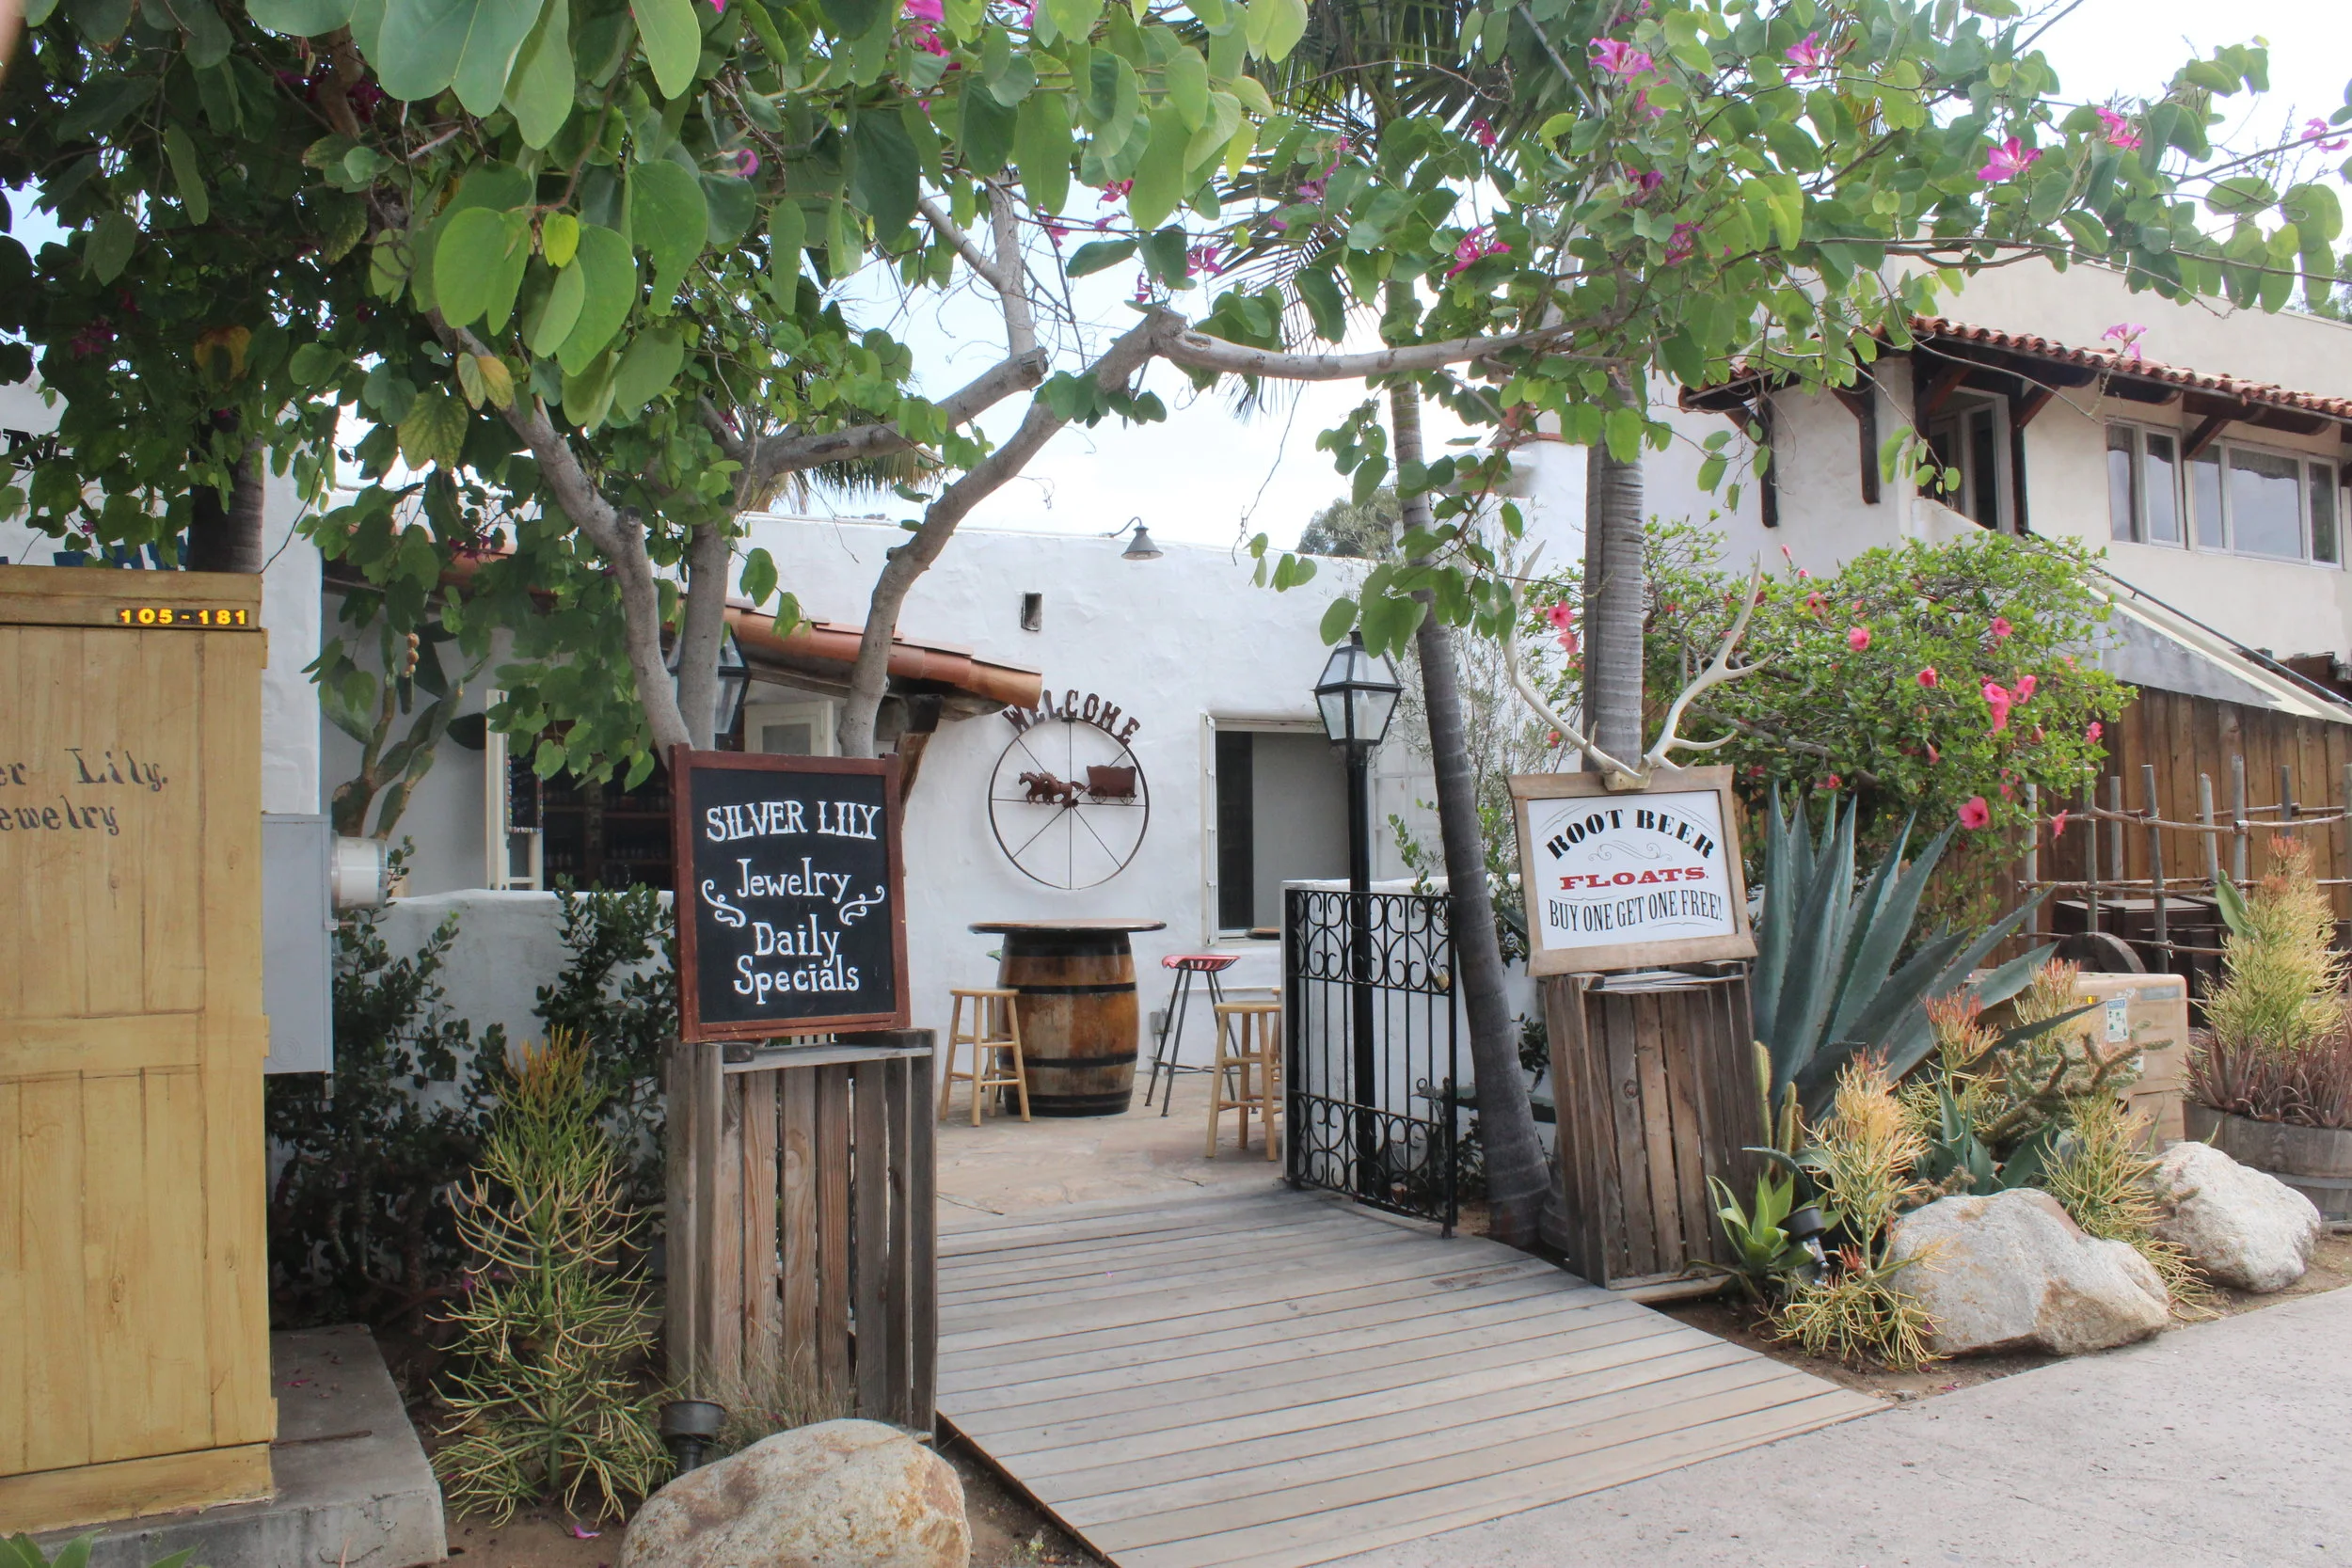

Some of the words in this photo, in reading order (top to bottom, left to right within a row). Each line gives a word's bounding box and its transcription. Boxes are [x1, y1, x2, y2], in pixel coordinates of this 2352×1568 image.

[120, 608, 247, 625] 105-181
[0, 795, 119, 836] ewelry
[707, 800, 808, 842] SILVER
[817, 800, 881, 840] LILY
[1546, 809, 1624, 861] ROOT
[1636, 809, 1714, 860] BEER
[737, 857, 851, 904] Jewelry
[1549, 898, 1578, 932] BUY
[1583, 901, 1613, 932] ONE
[1616, 895, 1645, 927] GET
[1648, 890, 1677, 921] ONE
[1681, 889, 1724, 922] FREE!
[752, 913, 840, 966] Daily
[734, 954, 860, 1005] Specials
